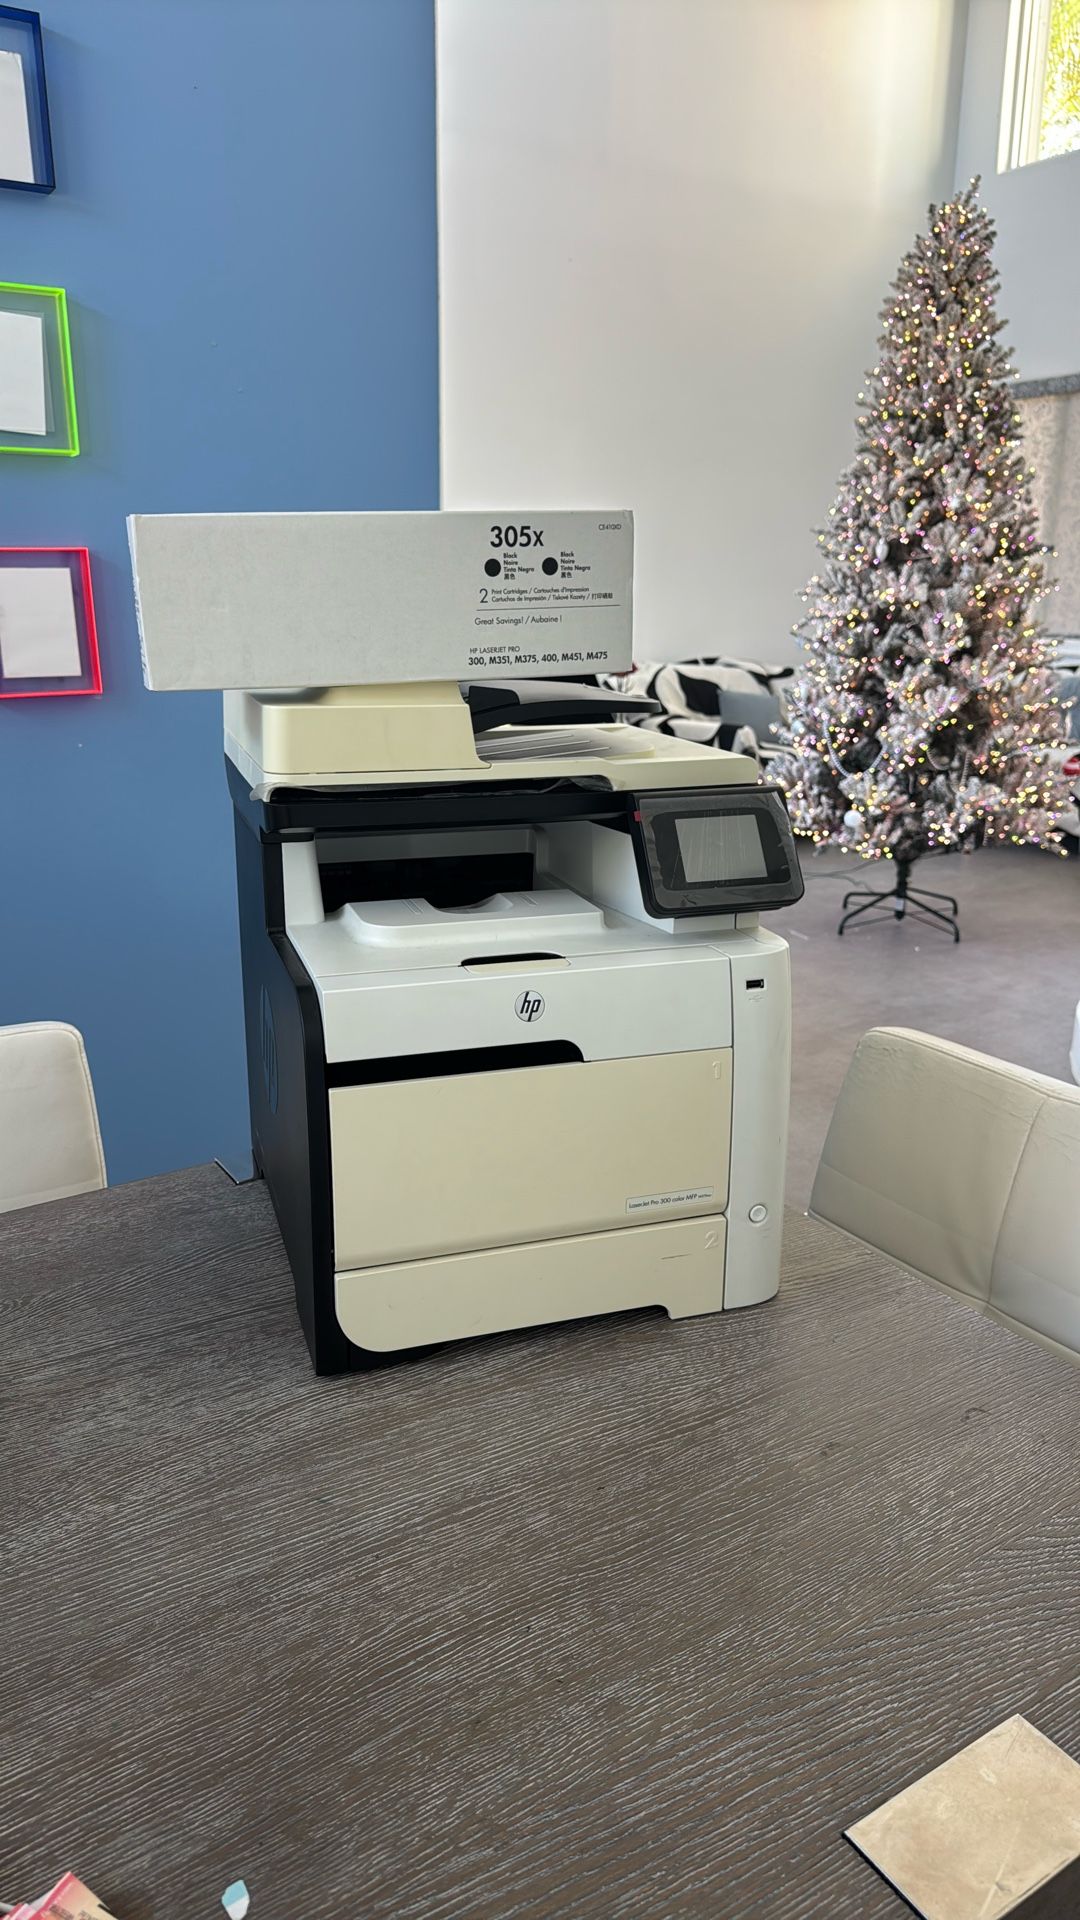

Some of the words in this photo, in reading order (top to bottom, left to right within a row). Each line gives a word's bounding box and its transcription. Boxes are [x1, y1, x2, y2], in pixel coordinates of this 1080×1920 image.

[479, 588, 488, 604] 2
[474, 617, 494, 626] Great
[496, 616, 524, 626] Savings!
[525, 615, 530, 624] /
[530, 615, 558, 624] Aubaine
[479, 646, 506, 654] LASERJET
[468, 657, 487, 667] 300,
[489, 656, 512, 666] M351,
[515, 655, 539, 664] M375,
[541, 653, 560, 663] 400,
[561, 652, 584, 662] M451,
[586, 651, 608, 660] M475
[520, 990, 542, 1022] hp
[629, 1201, 650, 1209] LaserJet
[660, 1197, 671, 1205] 300
[704, 1230, 719, 1250] 2
